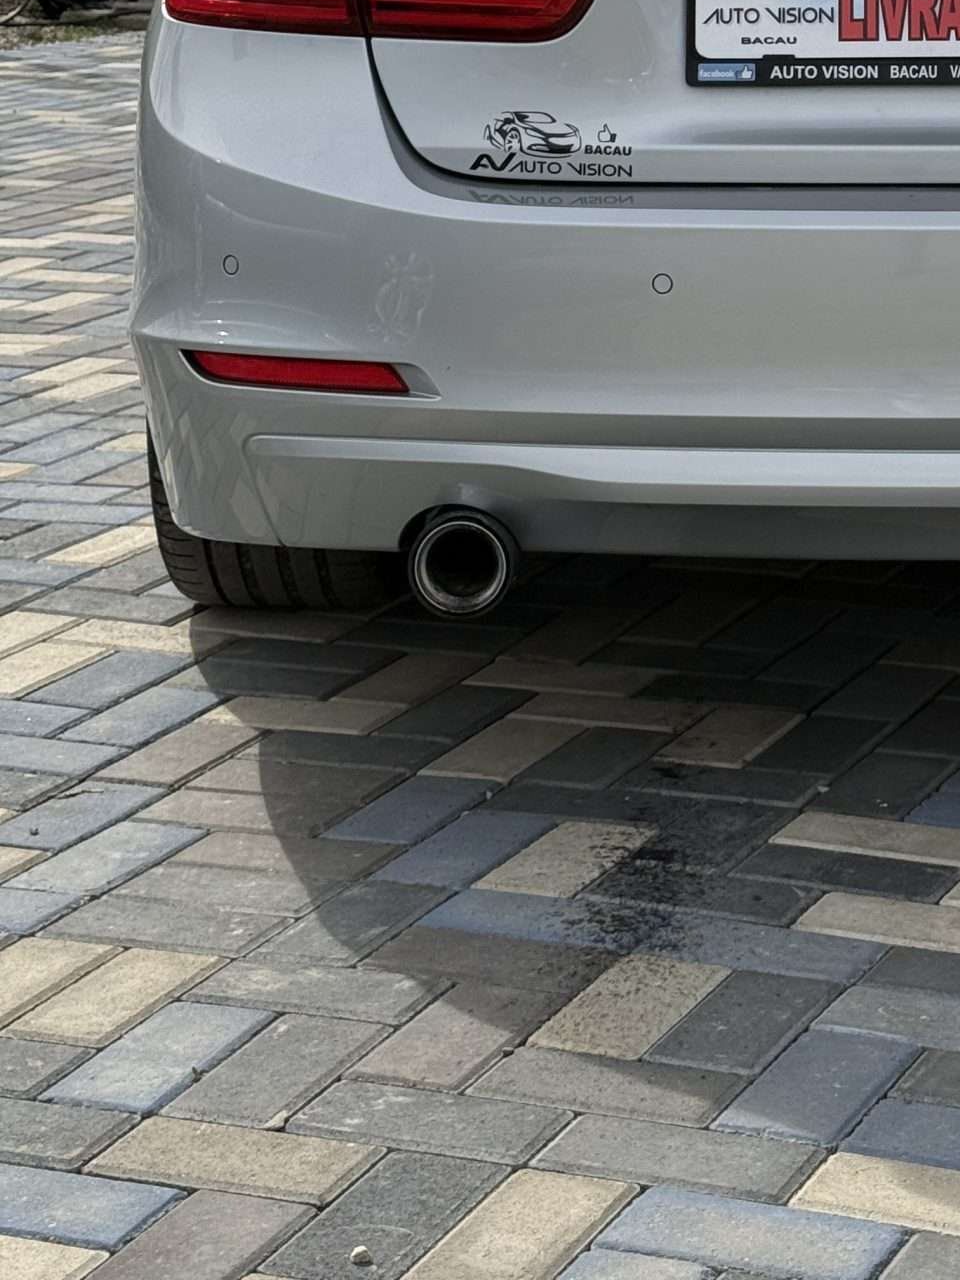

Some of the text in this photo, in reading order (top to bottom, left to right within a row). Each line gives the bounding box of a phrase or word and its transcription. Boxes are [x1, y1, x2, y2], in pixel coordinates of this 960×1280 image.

[702, 6, 835, 25] AUTO VISION
[740, 36, 798, 46] BACAU
[699, 68, 736, 79] facebook
[770, 65, 818, 80] AUTO
[822, 64, 879, 80] VISION
[890, 64, 938, 80] BACAU
[584, 144, 632, 157] BACAU
[508, 160, 562, 175] AUTO
[567, 161, 633, 178] VISION
